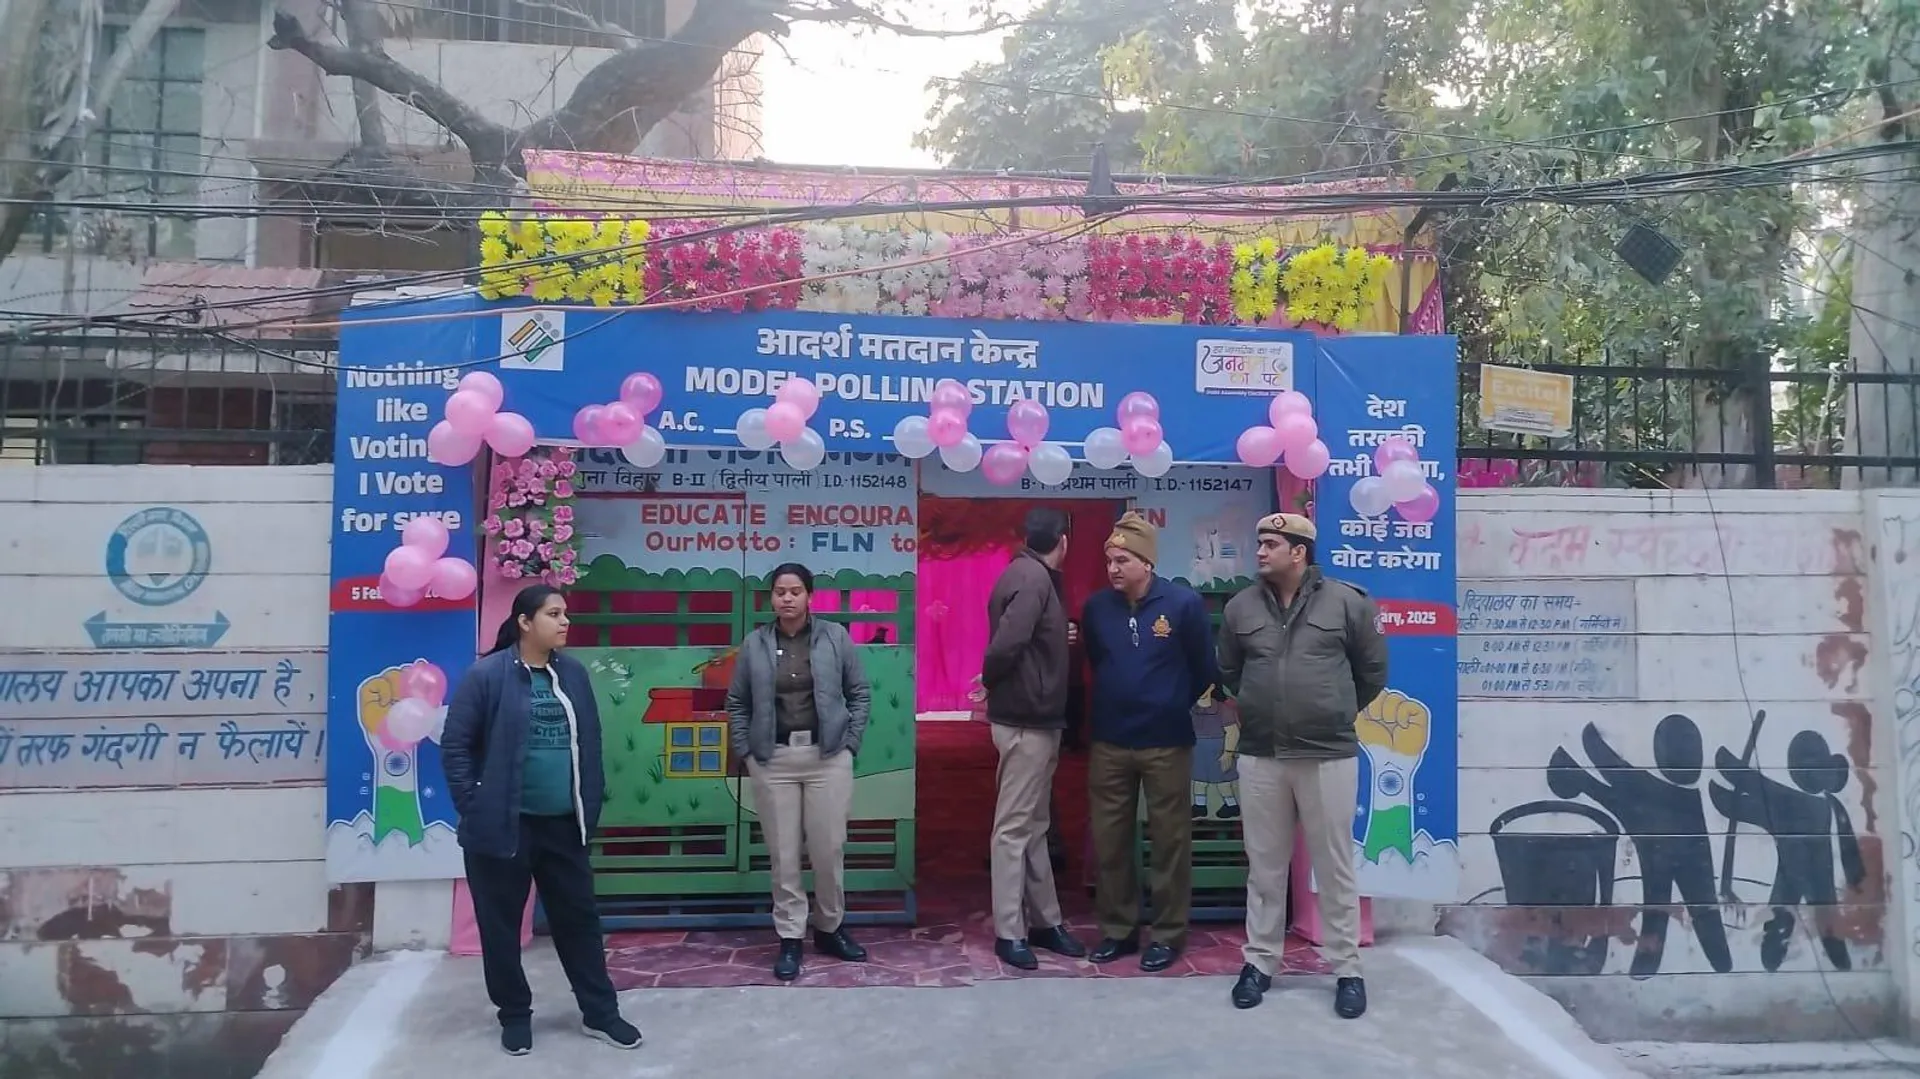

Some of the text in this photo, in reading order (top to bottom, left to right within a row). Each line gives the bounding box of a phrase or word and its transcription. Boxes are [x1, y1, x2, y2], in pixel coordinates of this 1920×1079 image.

[757, 323, 1040, 369] आदर्श मतदान केन्द्र
[347, 361, 460, 390] Nothing
[685, 366, 1105, 408] MODE POLLIN STATION
[376, 398, 428, 422] like
[1366, 395, 1406, 418] देश
[659, 411, 704, 430] A.C.
[829, 418, 871, 438] P.S.
[350, 433, 440, 463] Votin
[1329, 454, 1371, 477] तभी
[359, 471, 443, 495] I Vote
[342, 508, 387, 532] for
[642, 504, 913, 526] EDUCATE ENCOURA
[1339, 514, 1433, 541] कोई जब
[812, 532, 874, 552] FLN
[1331, 544, 1441, 570] वोट करेगा
[352, 587, 361, 600] 5
[1407, 611, 1436, 624] 2025
[74, 671, 180, 702] आपका
[183, 671, 266, 701] अपना
[17, 734, 76, 766] तरफ
[82, 722, 169, 769] गंदगी
[177, 733, 206, 759] न
